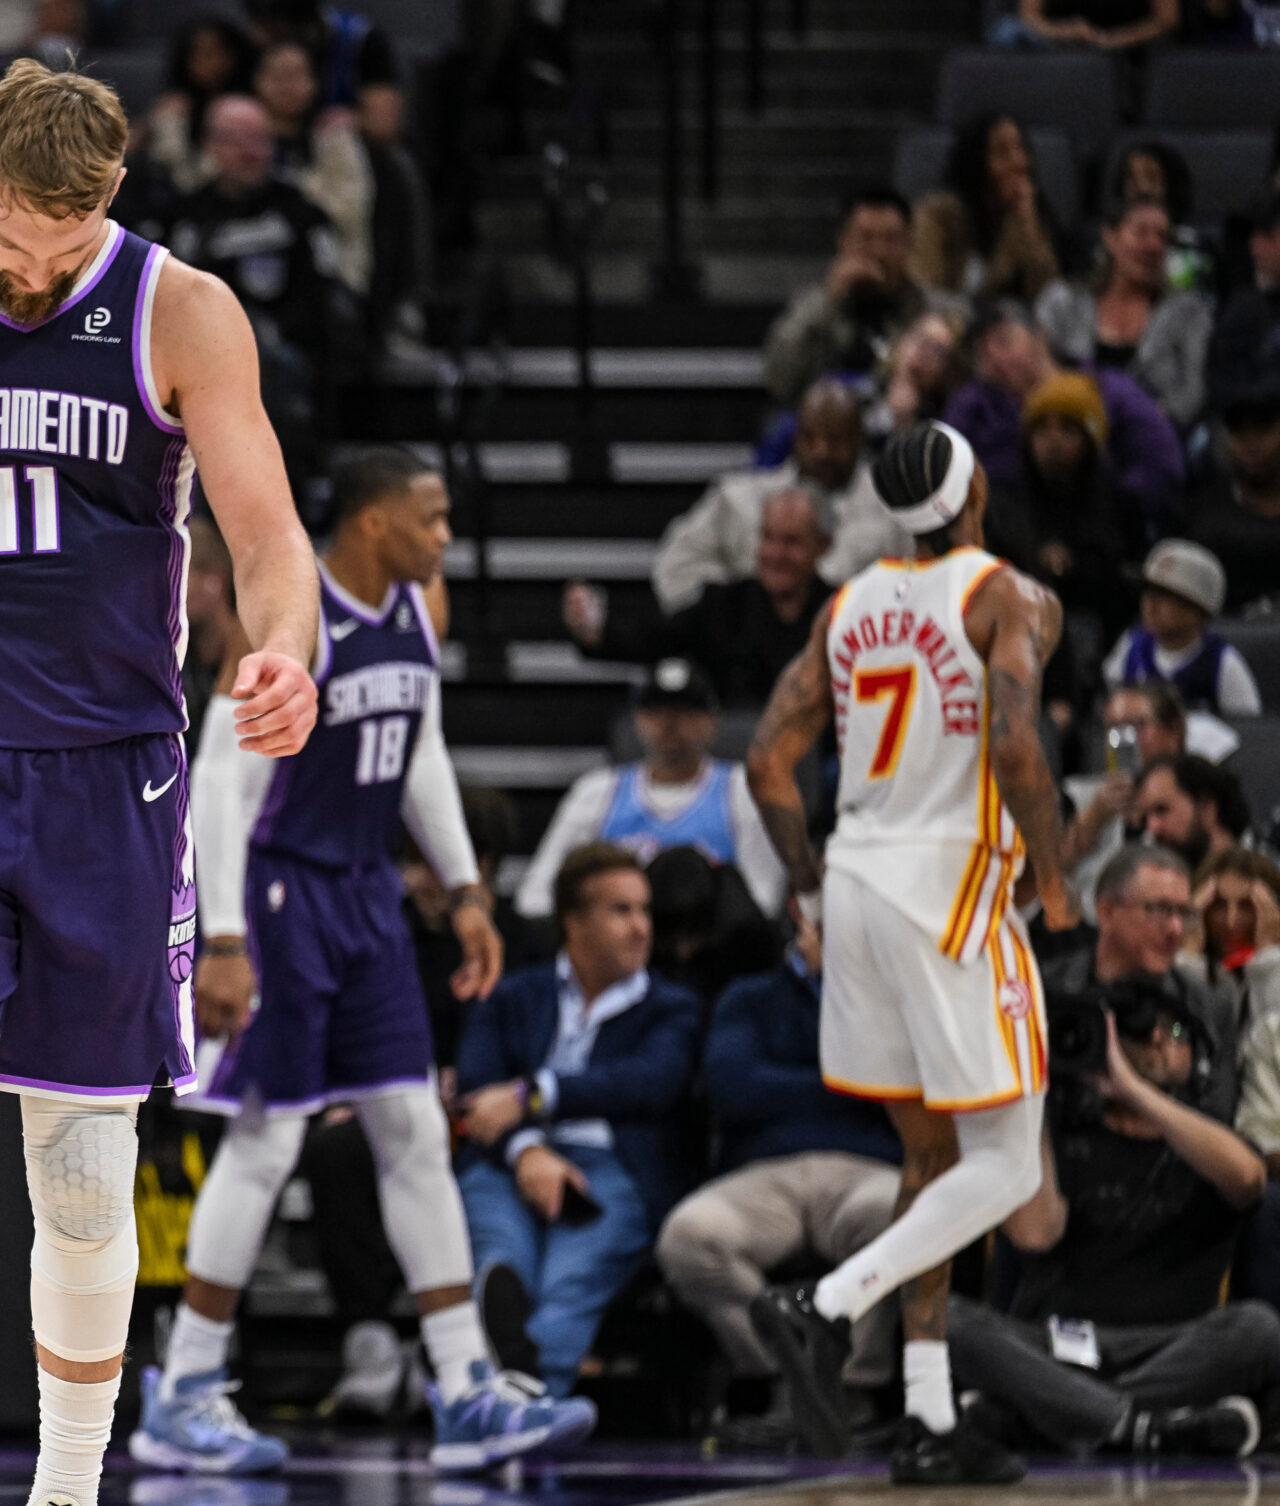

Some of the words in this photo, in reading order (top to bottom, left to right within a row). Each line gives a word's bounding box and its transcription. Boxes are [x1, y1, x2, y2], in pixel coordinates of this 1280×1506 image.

[71, 334, 103, 342] PHOONG
[356, 714, 410, 786] 18
[852, 661, 919, 781] 7
